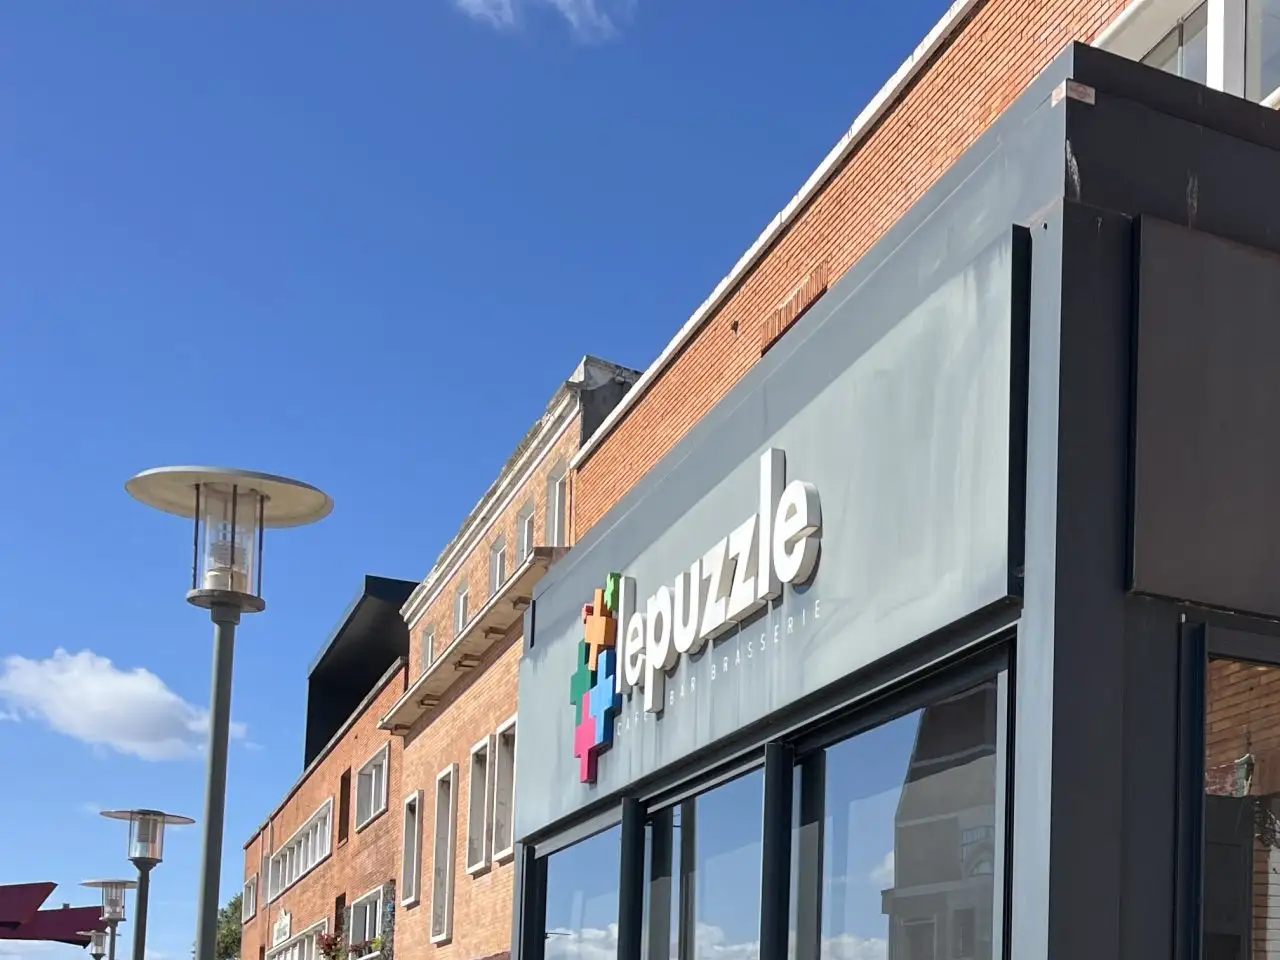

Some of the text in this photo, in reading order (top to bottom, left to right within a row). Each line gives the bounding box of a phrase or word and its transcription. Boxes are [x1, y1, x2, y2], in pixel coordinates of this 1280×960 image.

[616, 448, 822, 713] lepuzzle
[669, 676, 696, 705] BAR
[711, 600, 820, 680] BRASSERIE
